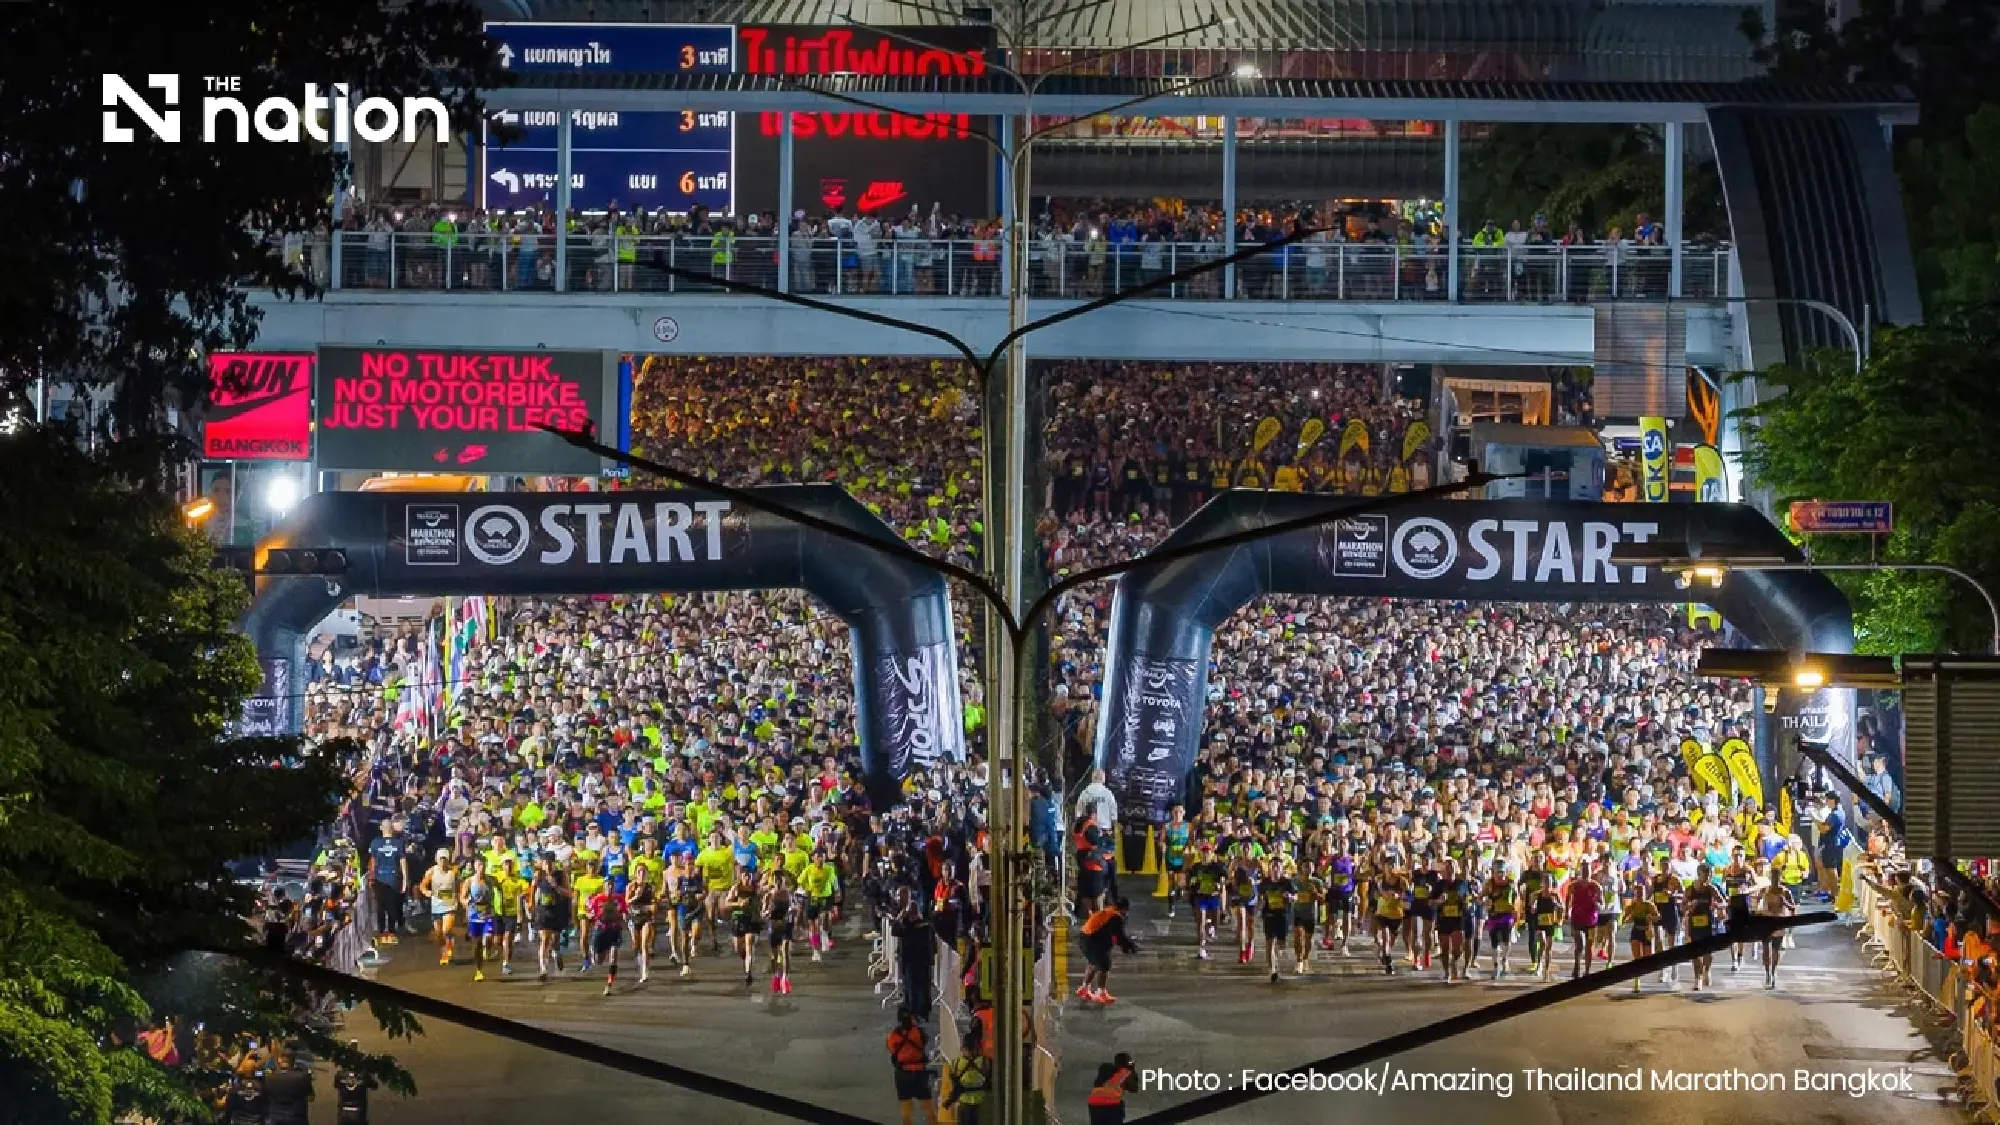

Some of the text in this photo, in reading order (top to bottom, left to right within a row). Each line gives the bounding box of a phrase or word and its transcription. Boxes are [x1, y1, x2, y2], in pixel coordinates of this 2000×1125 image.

[679, 44, 696, 69] 3
[699, 47, 729, 66] นาที
[679, 111, 695, 131] 3
[679, 171, 696, 195] 6
[697, 172, 728, 190] นาที
[361, 352, 561, 381] NO TUK-TUK.
[333, 378, 588, 407] NO MOTORBIKE.
[323, 402, 404, 429] JUST
[410, 404, 500, 431] YOUR
[210, 438, 303, 453] BANGKOK
[540, 501, 731, 564] START
[1465, 519, 1659, 584] START
[1142, 696, 1181, 709] TOYOTA
